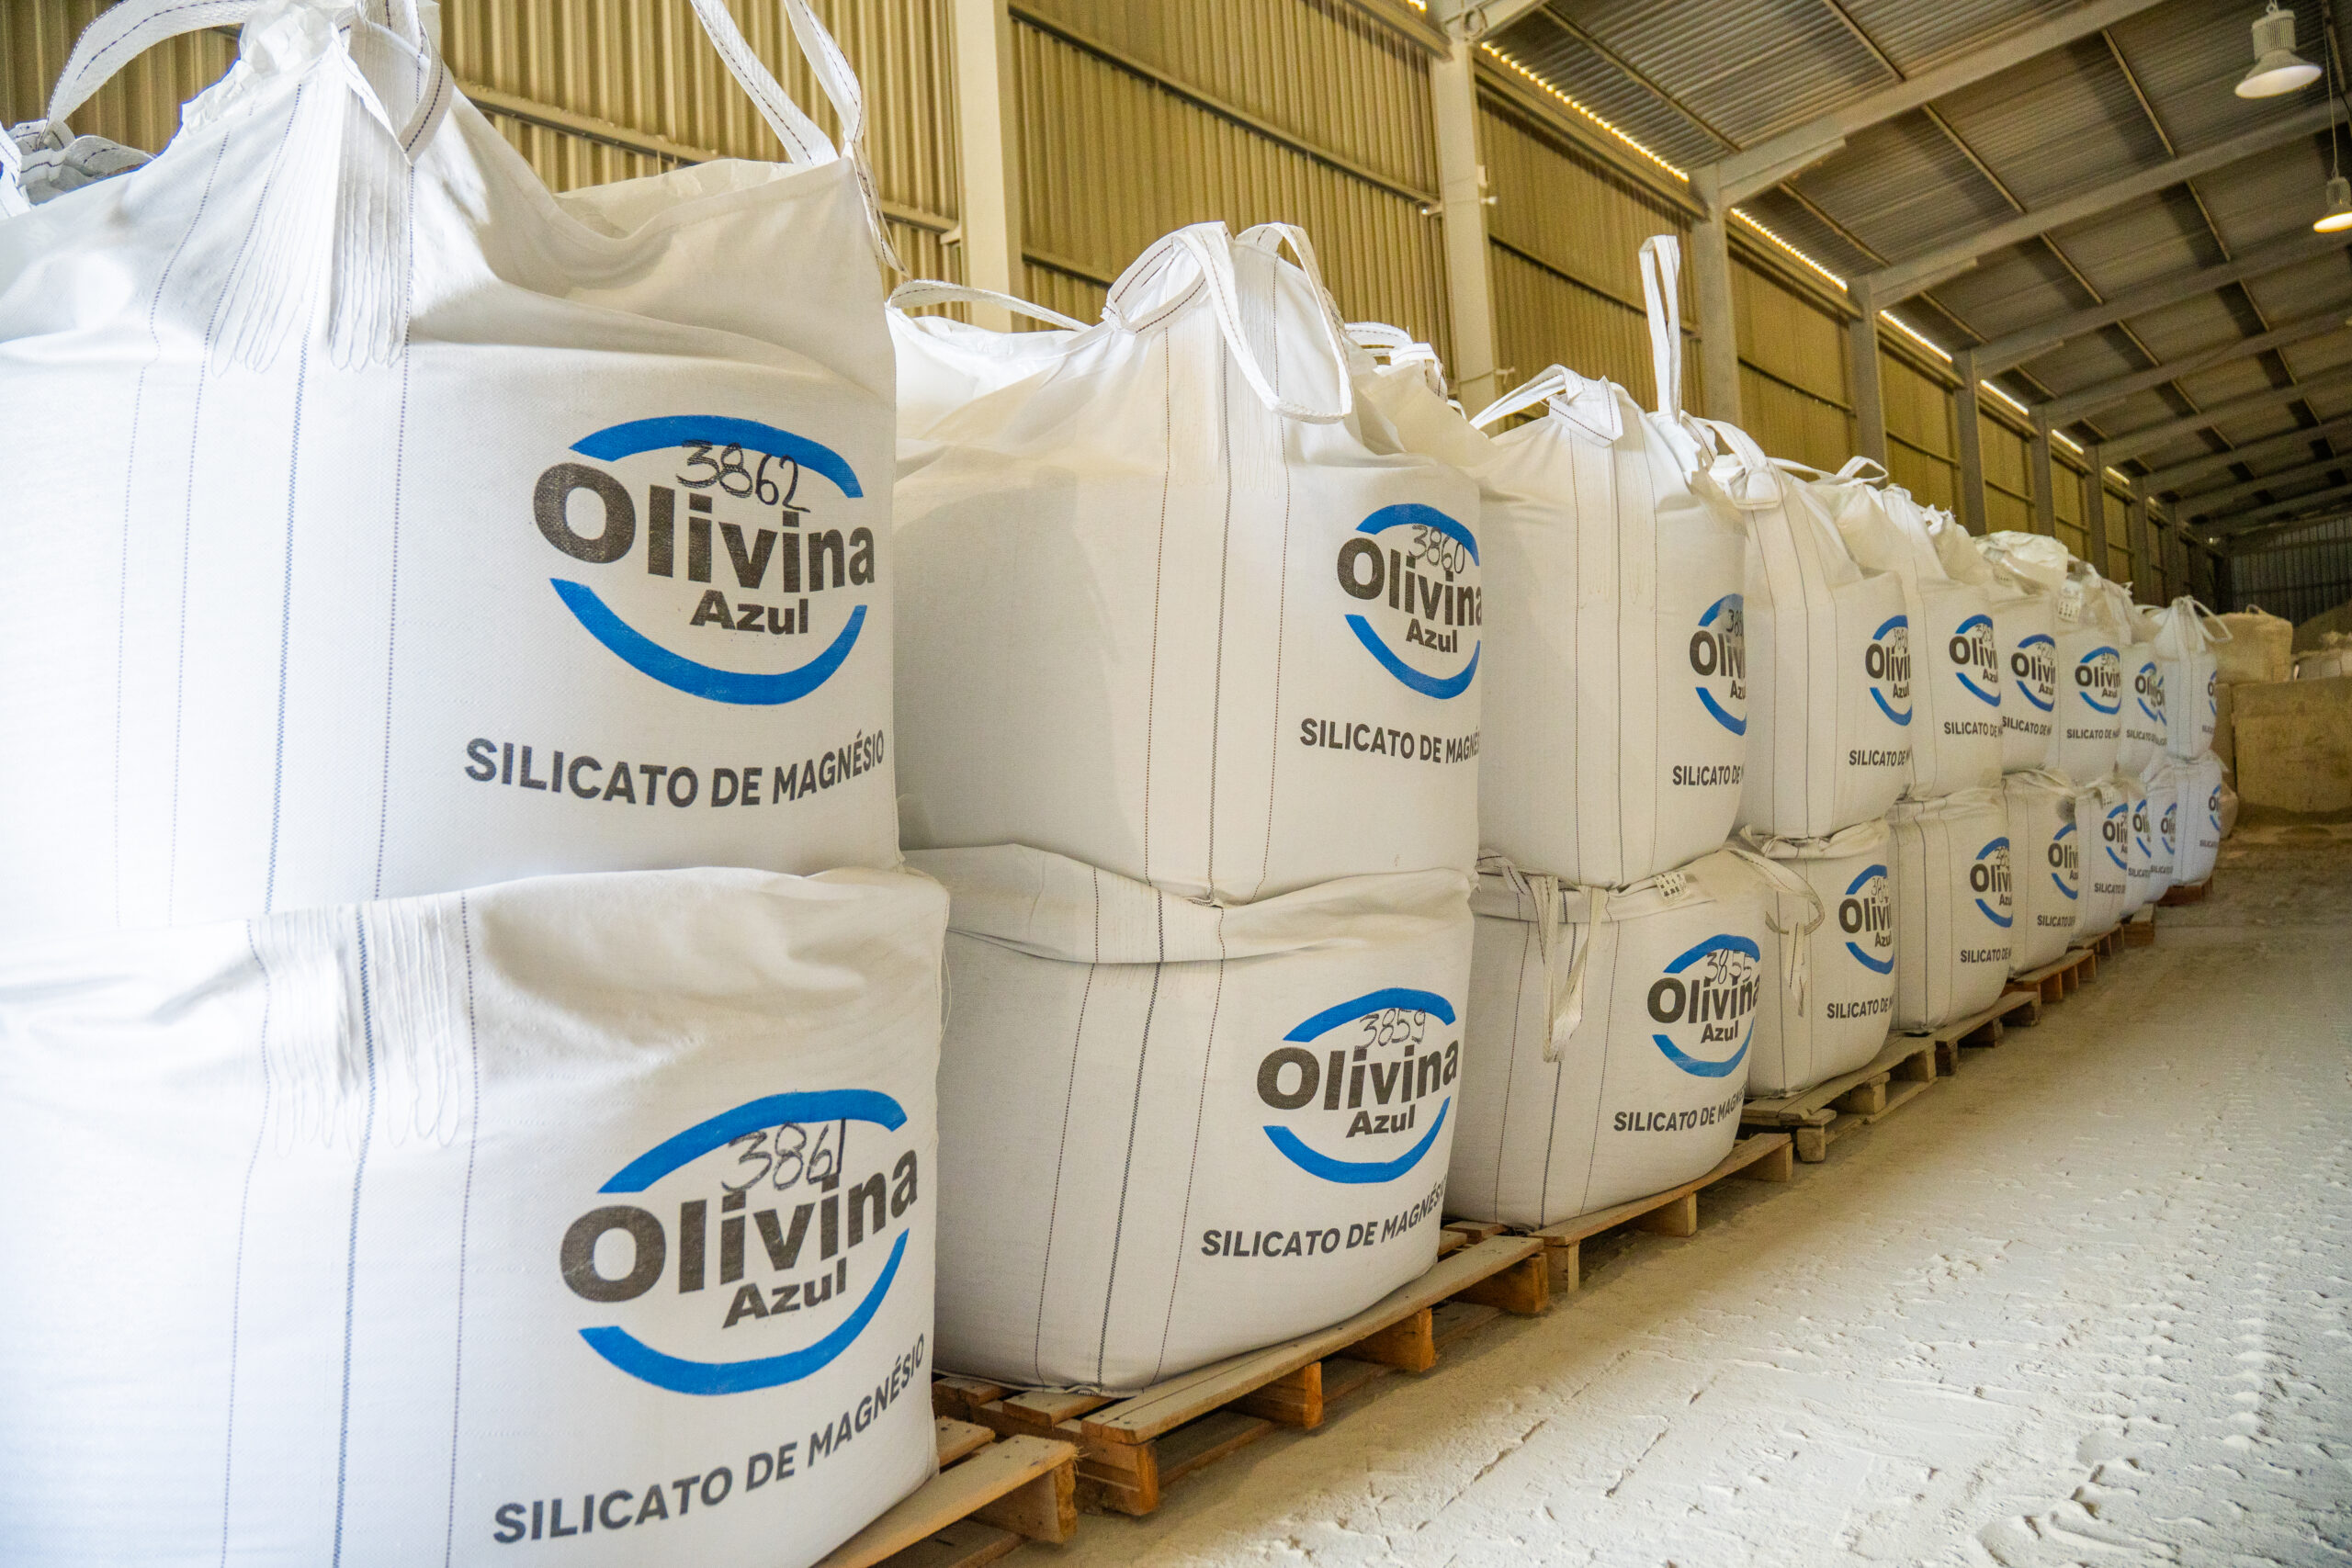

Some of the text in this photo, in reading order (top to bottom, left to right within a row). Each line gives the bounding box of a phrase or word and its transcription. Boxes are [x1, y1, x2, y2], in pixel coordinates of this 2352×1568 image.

[676, 440, 810, 513] 3862
[533, 462, 876, 593] Olivina
[1408, 524, 1465, 575] 3860
[690, 590, 809, 635] Azul
[1406, 618, 1458, 653] Azul
[1300, 717, 1415, 760] SILICATO
[1419, 734, 1442, 763] DE
[1943, 721, 1989, 735] SILICATO
[2002, 716, 2039, 735] SILICATO
[2066, 728, 2104, 739] SILICATO
[464, 728, 885, 807] SILICATO DE MAGNÉSIO
[1672, 765, 1731, 786] SILICATO
[1731, 764, 1741, 784] DE
[1849, 750, 1897, 767] SILICATO
[1960, 949, 2000, 963] SILICATO
[1826, 998, 1879, 1019] SILICATO
[1880, 998, 1889, 1013] DE
[1353, 1008, 1426, 1050] 3859
[1701, 1020, 1739, 1043] Azul
[1257, 1040, 1459, 1111] Olivina
[1346, 1104, 1416, 1138] Azul
[1613, 1110, 1698, 1132] SILICATO
[1700, 1106, 1717, 1126] DE
[721, 1117, 847, 1192] 3861
[560, 1149, 918, 1303] Olivina
[1201, 1227, 1340, 1257] SILICATO
[1346, 1222, 1378, 1249] DE
[722, 1258, 847, 1328] Azul
[492, 1333, 925, 1544] SILICATO DE MAGNÉSIO
